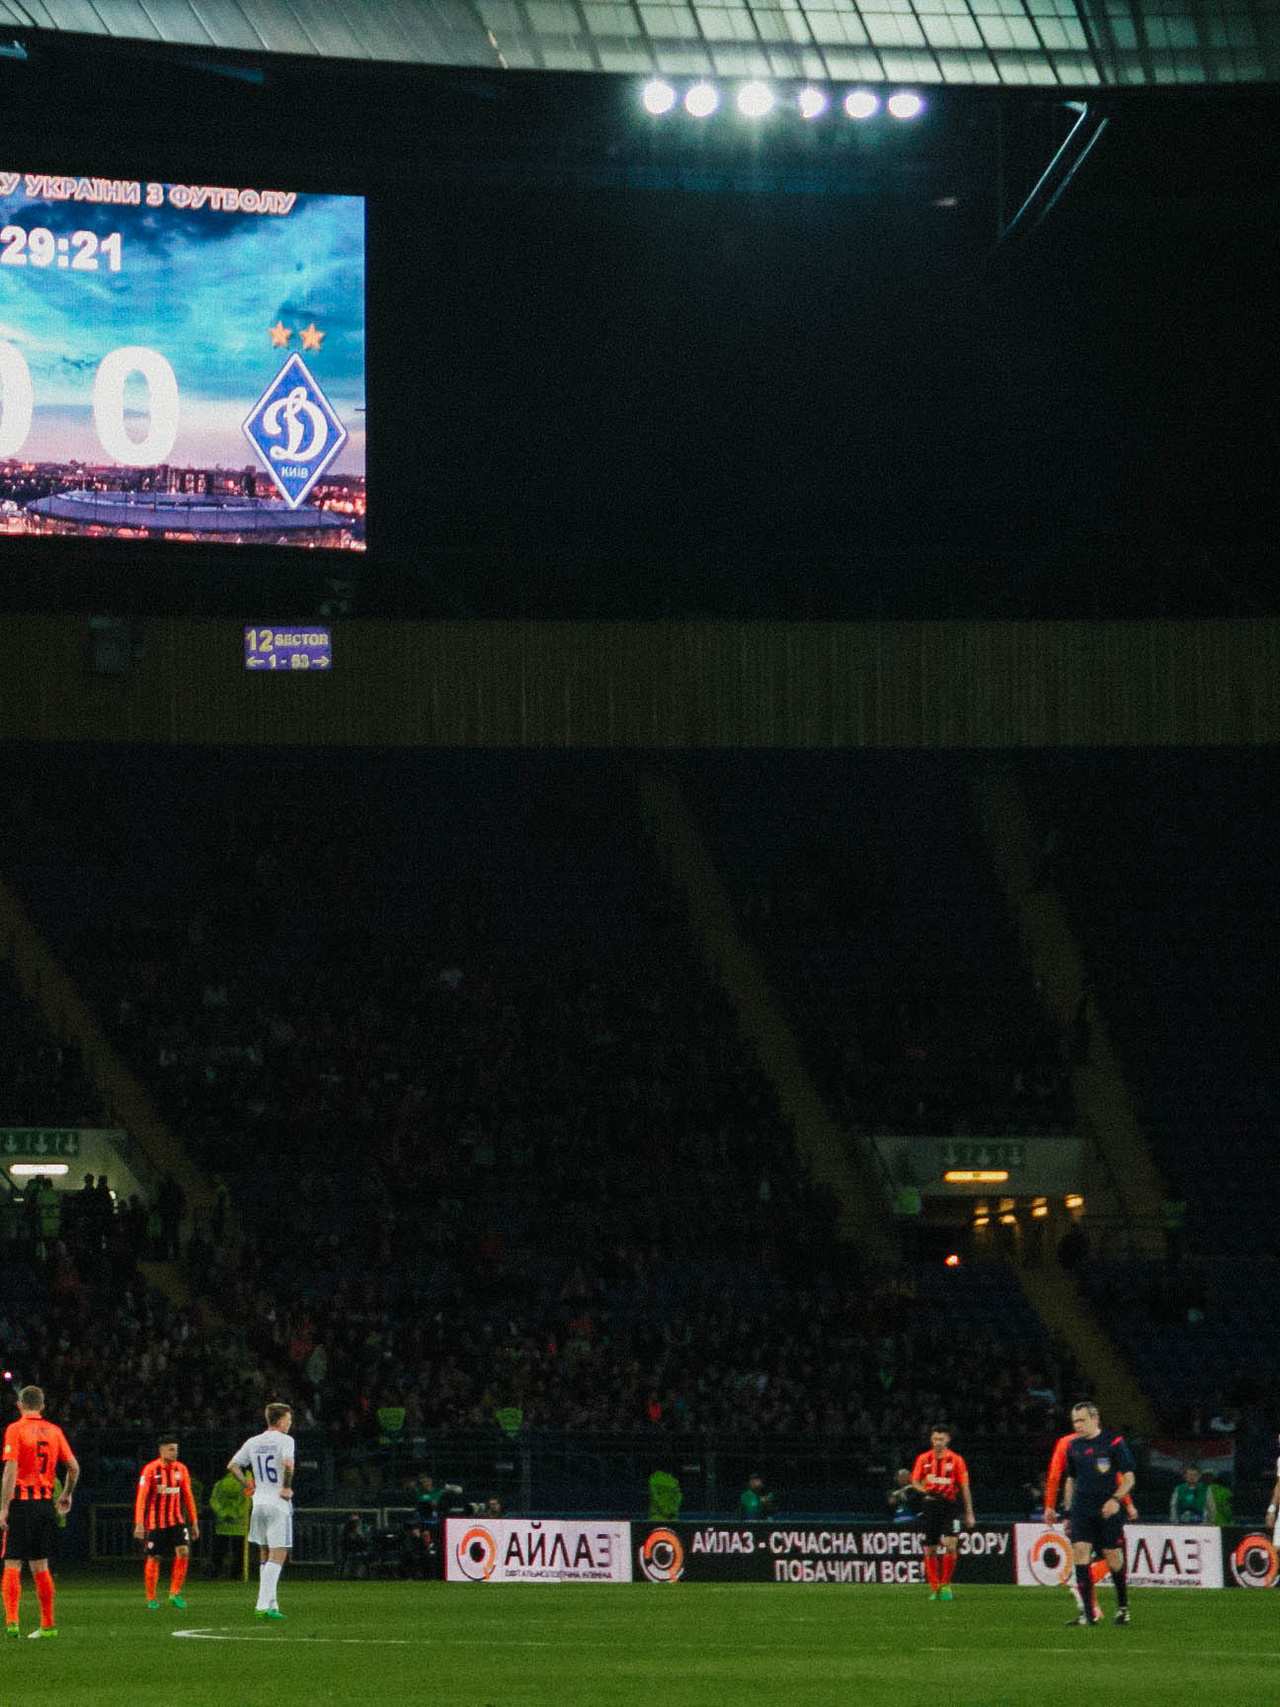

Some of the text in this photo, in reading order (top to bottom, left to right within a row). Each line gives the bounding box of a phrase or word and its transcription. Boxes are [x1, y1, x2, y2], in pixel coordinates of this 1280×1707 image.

[25, 174, 141, 206] УКРАЇНИ
[146, 182, 163, 207] З
[169, 185, 297, 214] ФУТБОЛУ
[0, 225, 121, 271] 29:21
[94, 346, 179, 466] 0
[246, 629, 328, 652] 12 SECTOR
[269, 654, 276, 668] 1
[37, 1441, 48, 1473] 5
[258, 1455, 278, 1483] 16
[505, 1522, 612, 1568] АЙЛАЗ
[692, 1528, 755, 1553] АЙЛАЗ
[770, 1531, 858, 1554] СУЧАСНА
[862, 1532, 947, 1554] КОРЕК
[958, 1532, 1009, 1554] ЗОРУ
[775, 1560, 877, 1583] ПОБАЧИТИ
